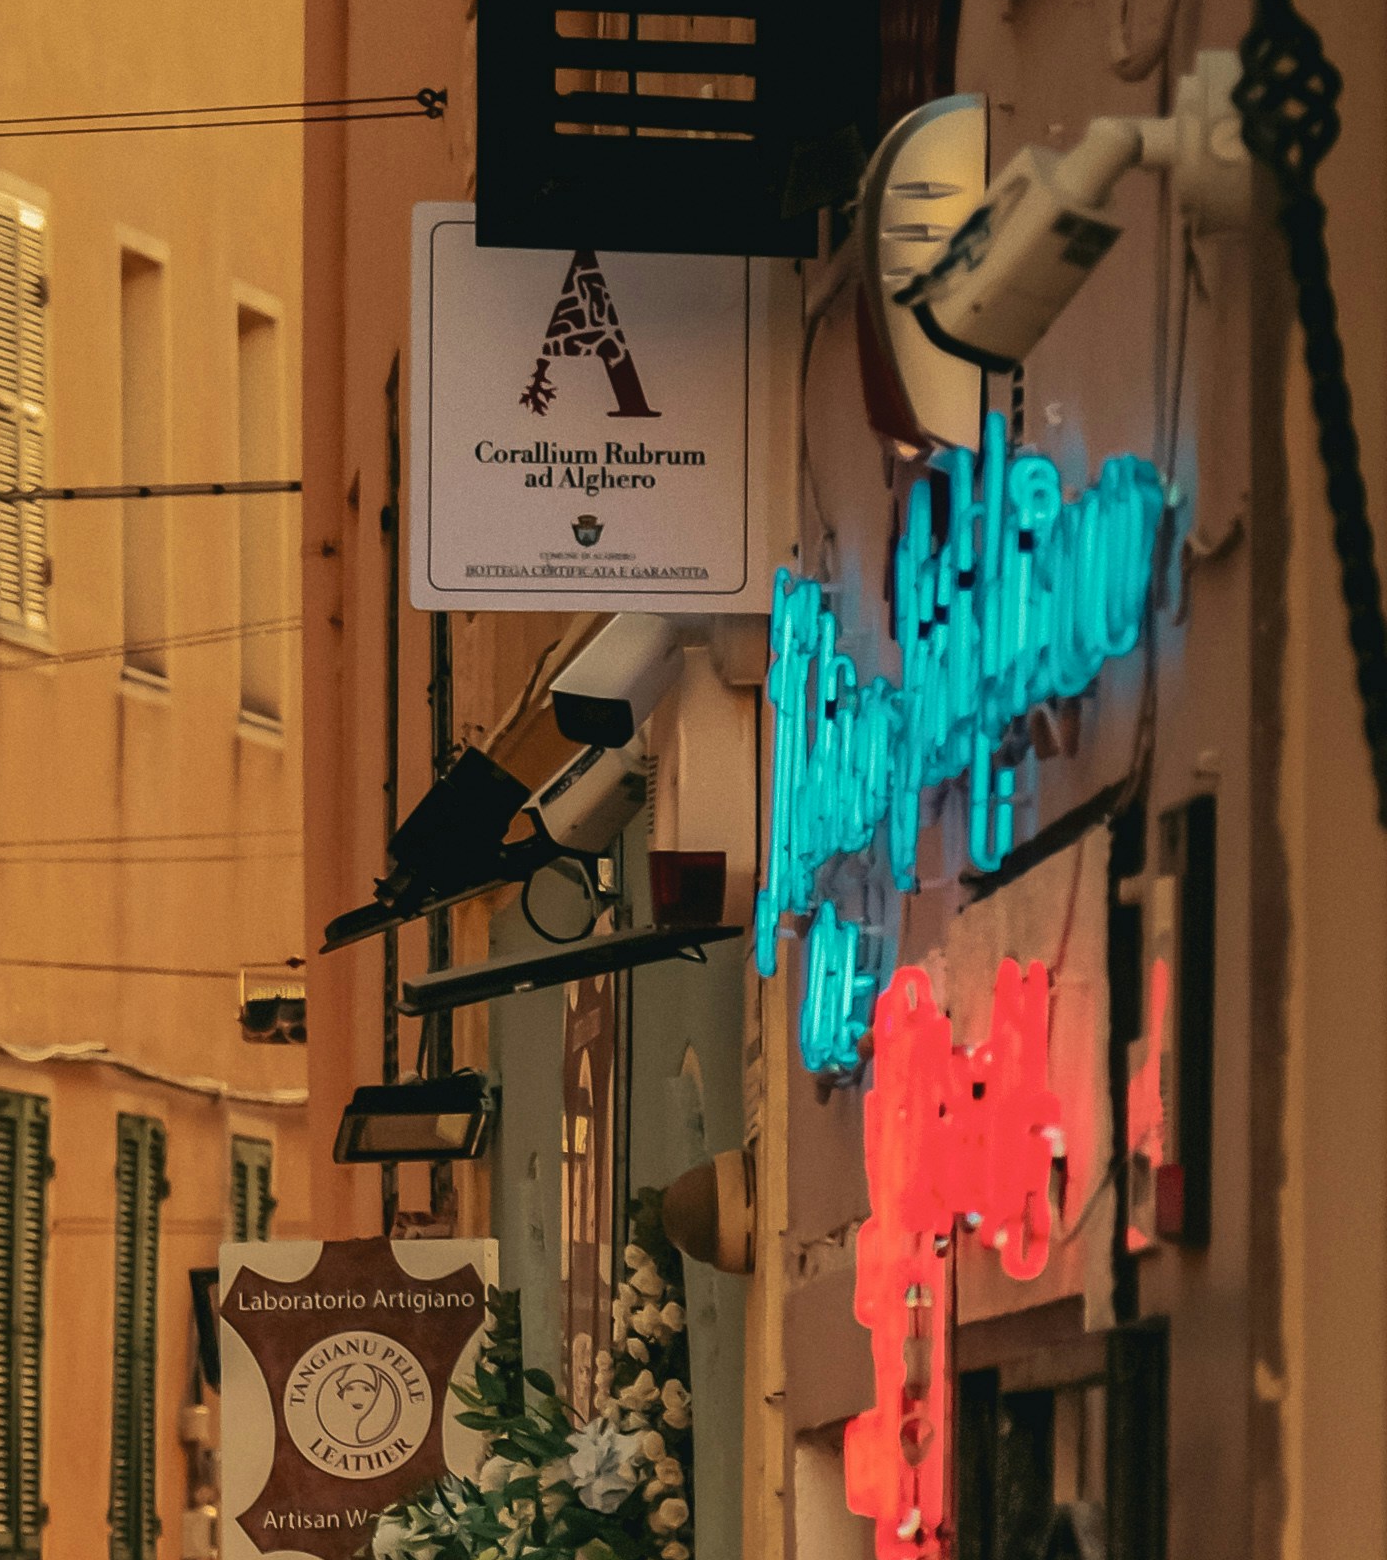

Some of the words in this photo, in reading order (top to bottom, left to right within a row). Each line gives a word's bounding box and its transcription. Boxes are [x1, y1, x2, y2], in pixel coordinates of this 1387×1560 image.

[474, 440, 598, 465] Corallium
[604, 441, 706, 466] Rubrum
[524, 466, 553, 489] ad
[558, 465, 657, 498] Alghero
[465, 564, 529, 578] BOTTEGA
[531, 565, 617, 578] CERTIFICATA
[631, 566, 709, 579] GARANTITA
[238, 1288, 366, 1312] Laboratorio
[373, 1288, 476, 1314] Artigiano
[289, 1338, 378, 1407] TANGIANU
[381, 1347, 425, 1405] PELLE
[308, 1437, 414, 1473] LEATHER
[263, 1509, 340, 1531] Artisan
